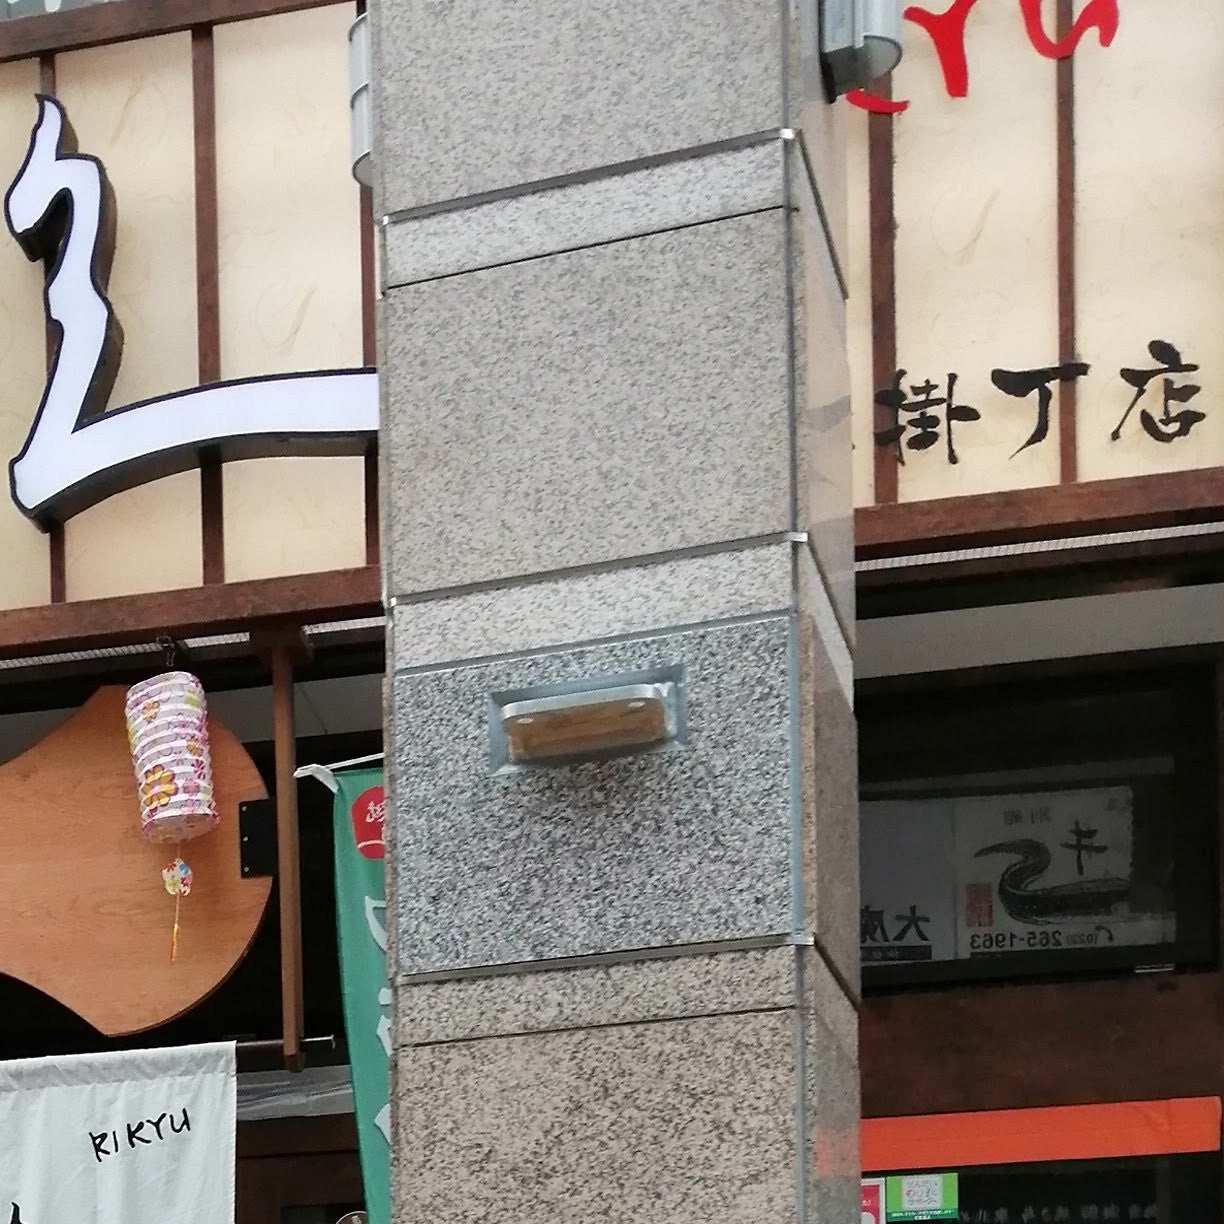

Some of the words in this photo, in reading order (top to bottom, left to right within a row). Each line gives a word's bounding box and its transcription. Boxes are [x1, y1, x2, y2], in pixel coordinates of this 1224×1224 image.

[875, 340, 1206, 466] 掛丁店
[88, 1108, 192, 1163] RIKYU
